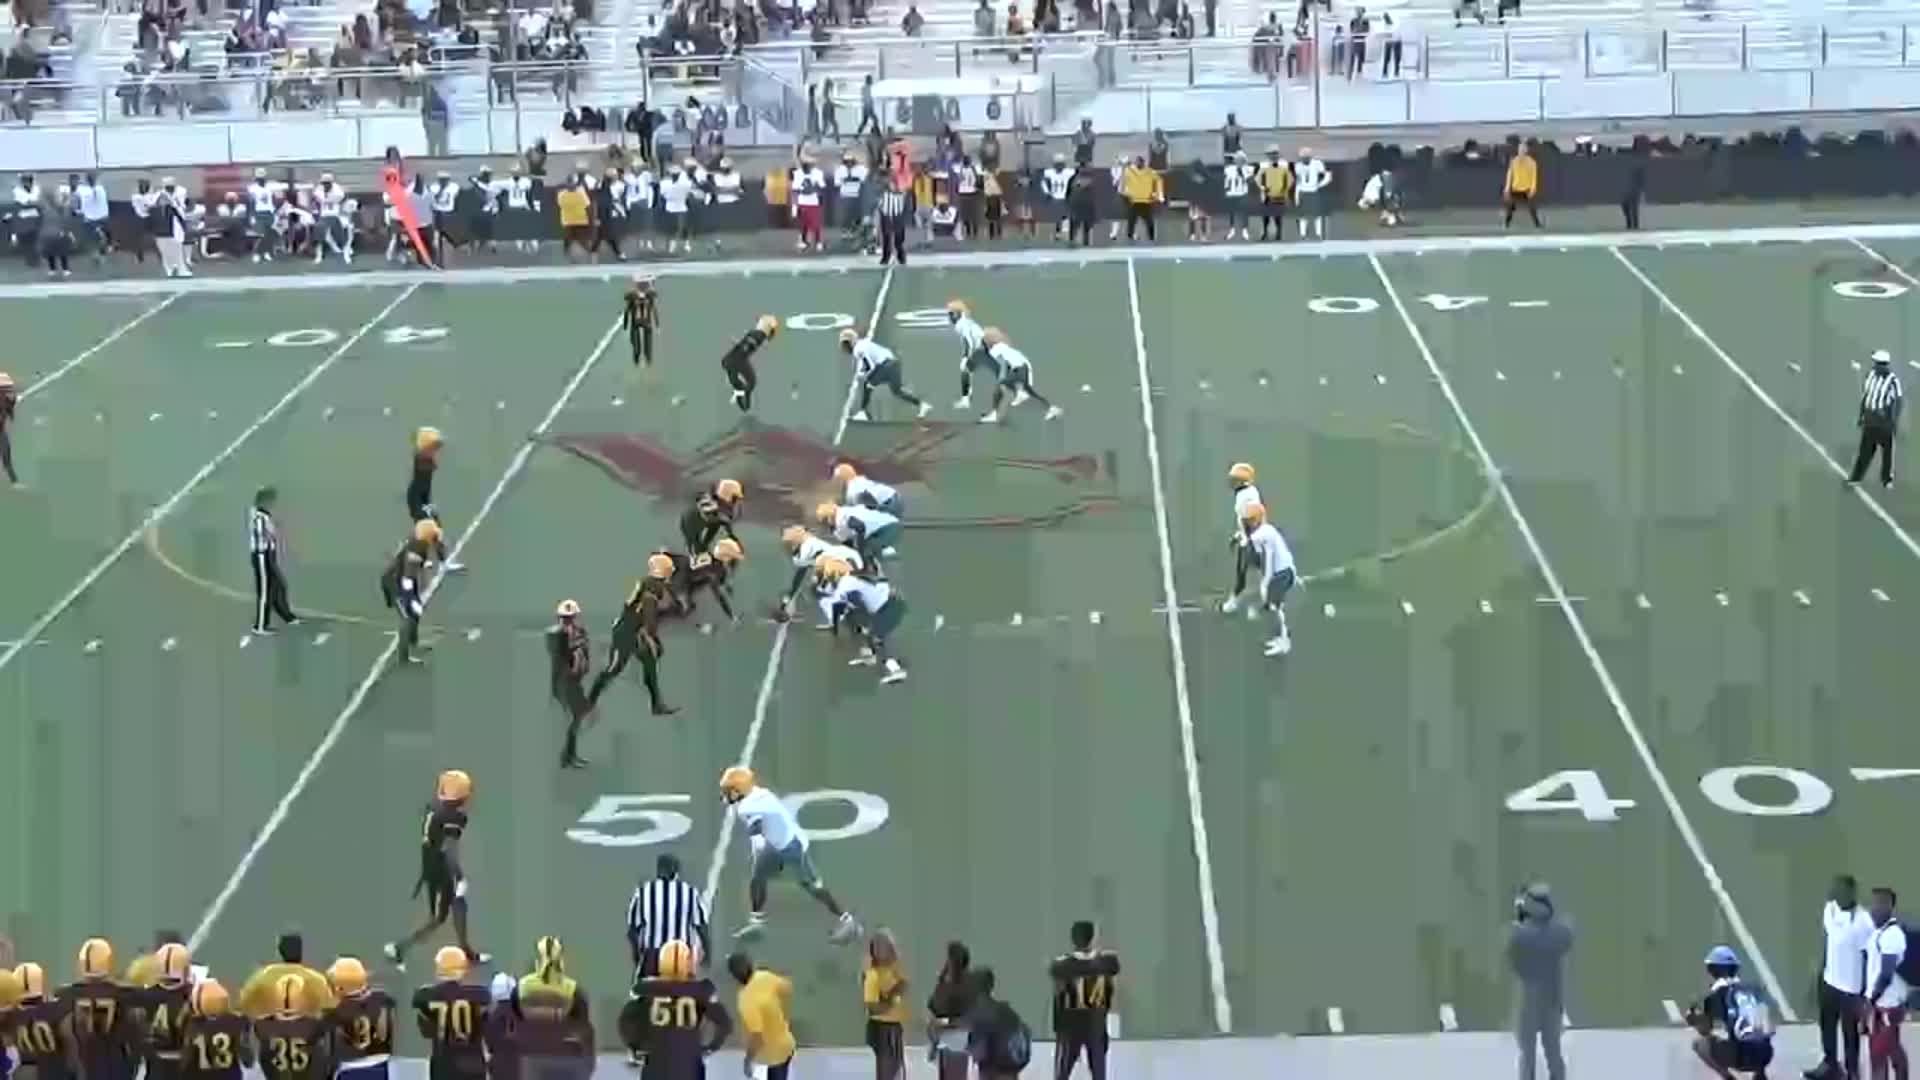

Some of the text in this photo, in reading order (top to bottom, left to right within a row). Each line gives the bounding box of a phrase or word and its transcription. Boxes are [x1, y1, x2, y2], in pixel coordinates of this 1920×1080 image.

[1505, 765, 1833, 821] 40
[564, 789, 889, 846] 50
[1076, 976, 1107, 1007] 14
[75, 998, 117, 1034] 77
[428, 999, 473, 1041] 70
[193, 1031, 233, 1069] 13
[269, 1036, 310, 1072] 35
